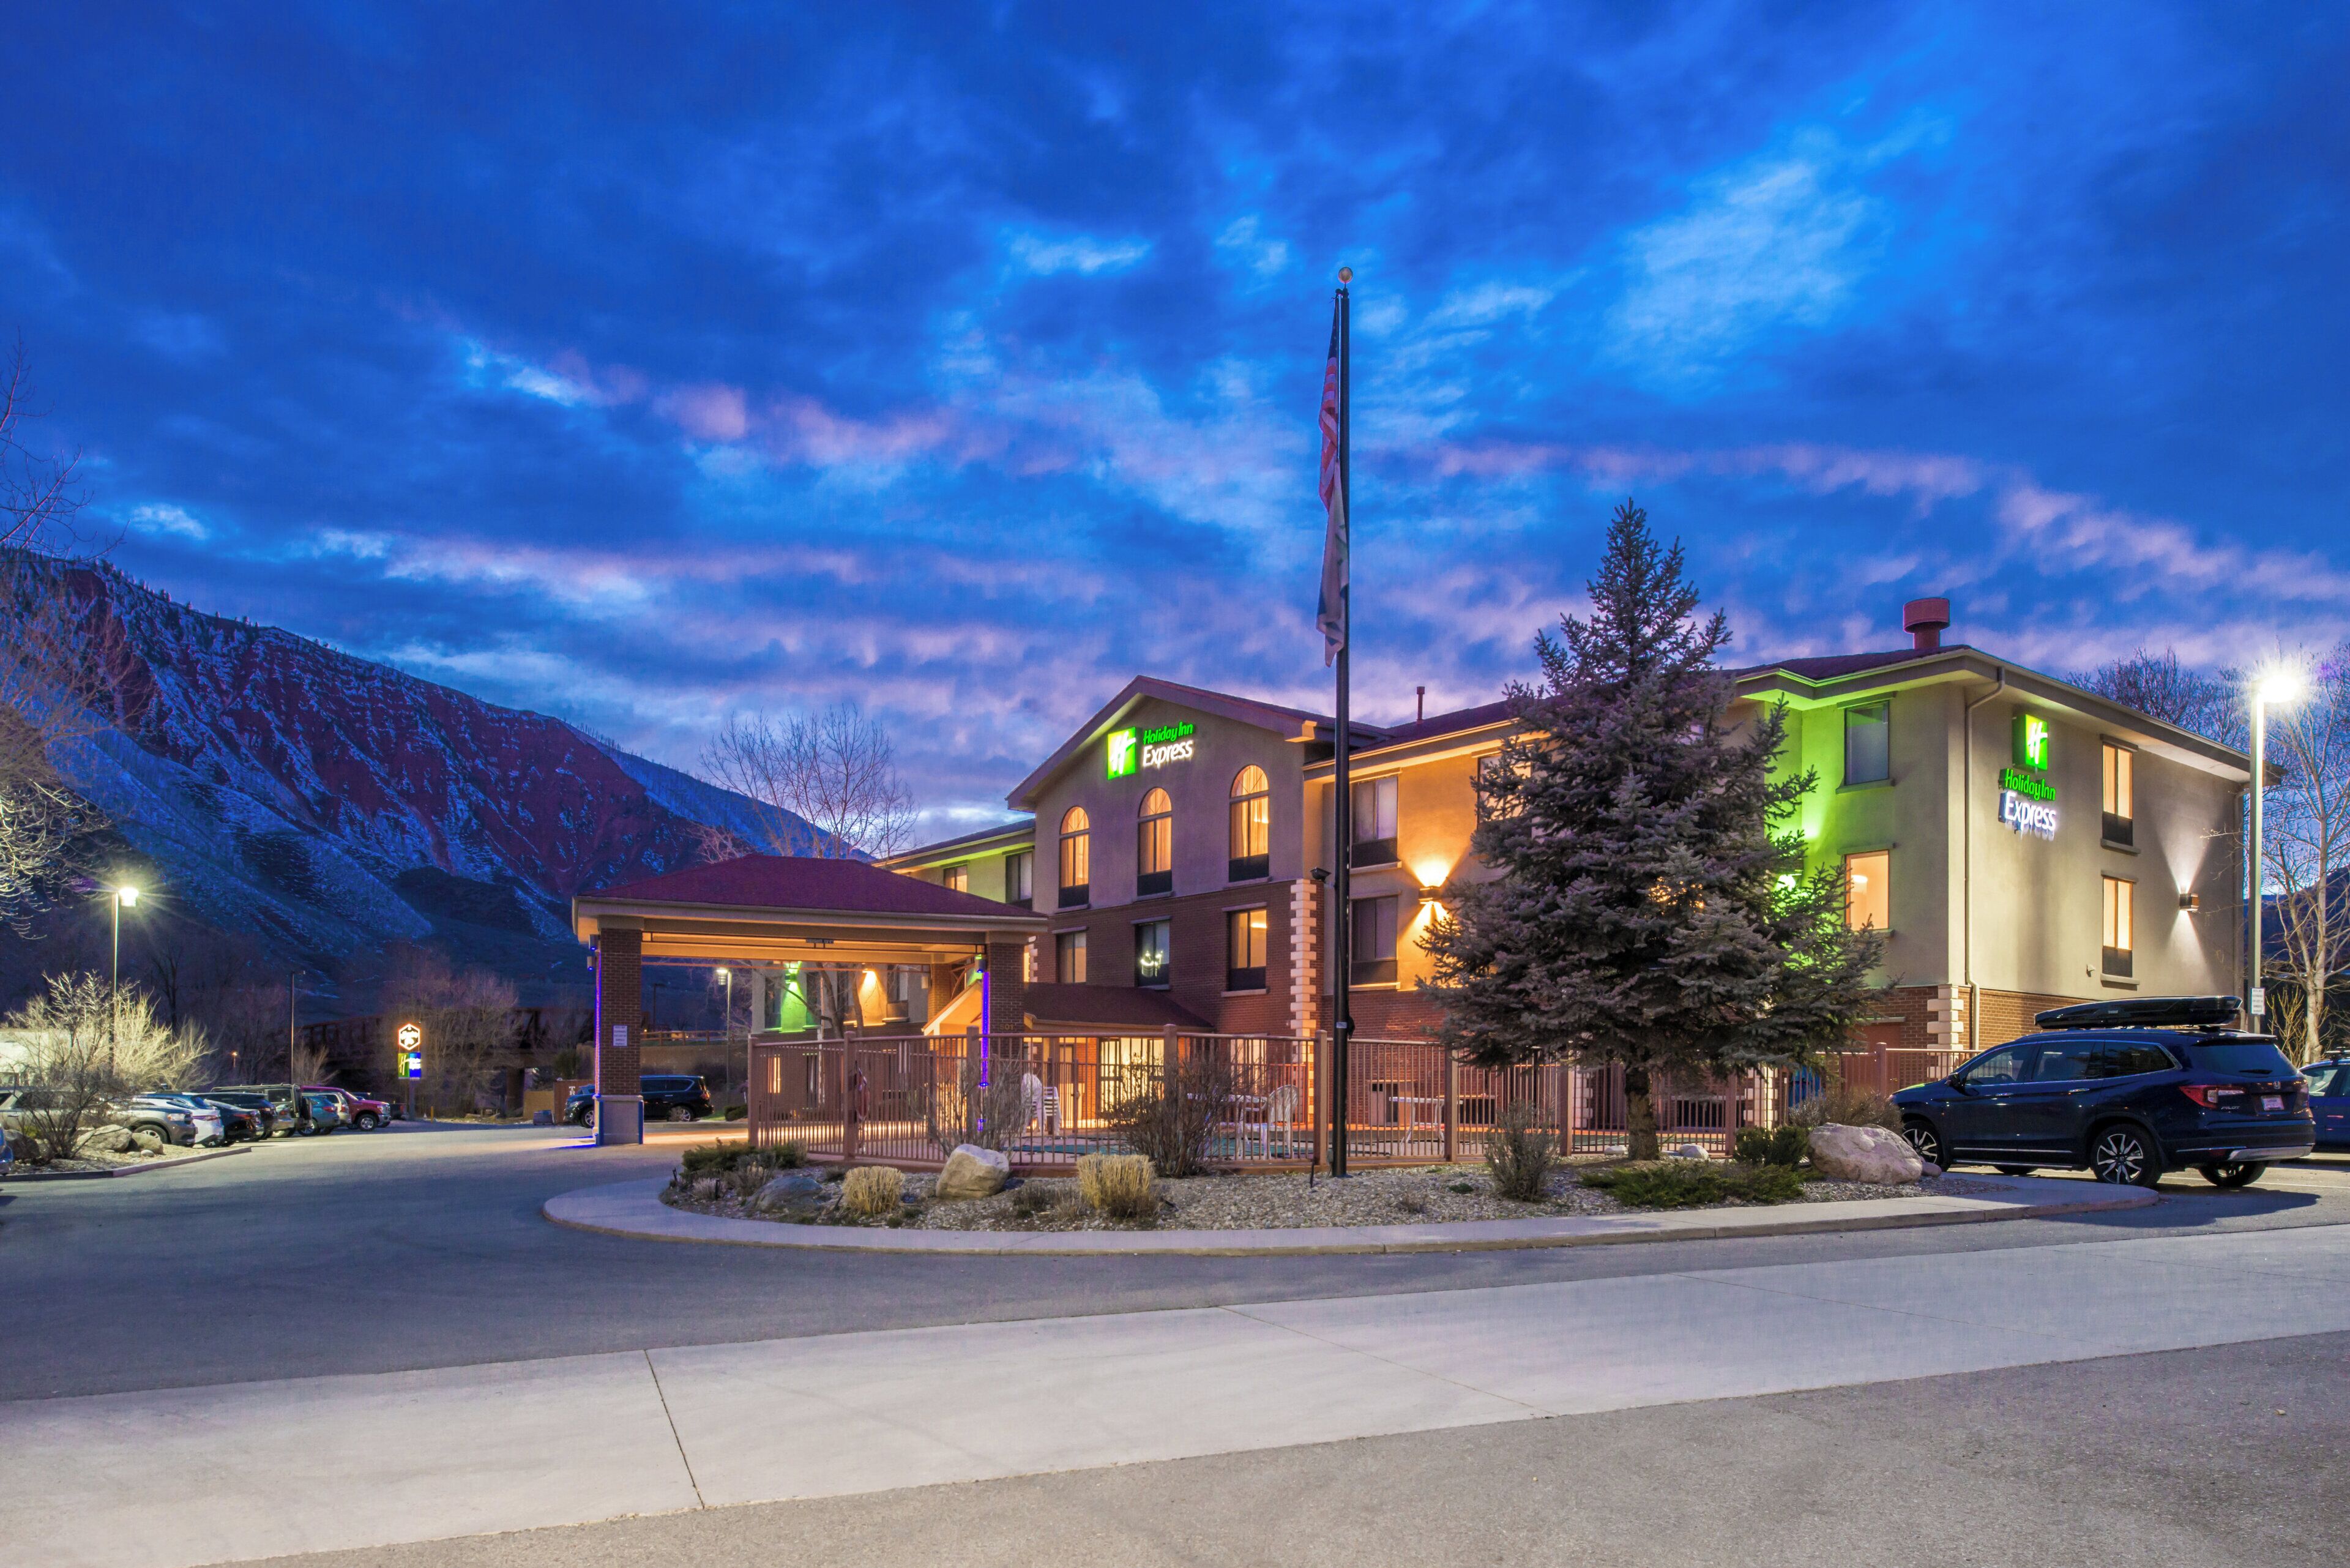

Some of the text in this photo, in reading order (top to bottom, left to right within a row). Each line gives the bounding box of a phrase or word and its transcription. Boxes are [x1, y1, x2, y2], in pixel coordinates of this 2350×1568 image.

[1143, 721, 1193, 745] Holiday Inn
[1143, 740, 1193, 769] Express
[2005, 768, 2056, 801] Holiday Inn
[2005, 791, 2056, 831] Express
